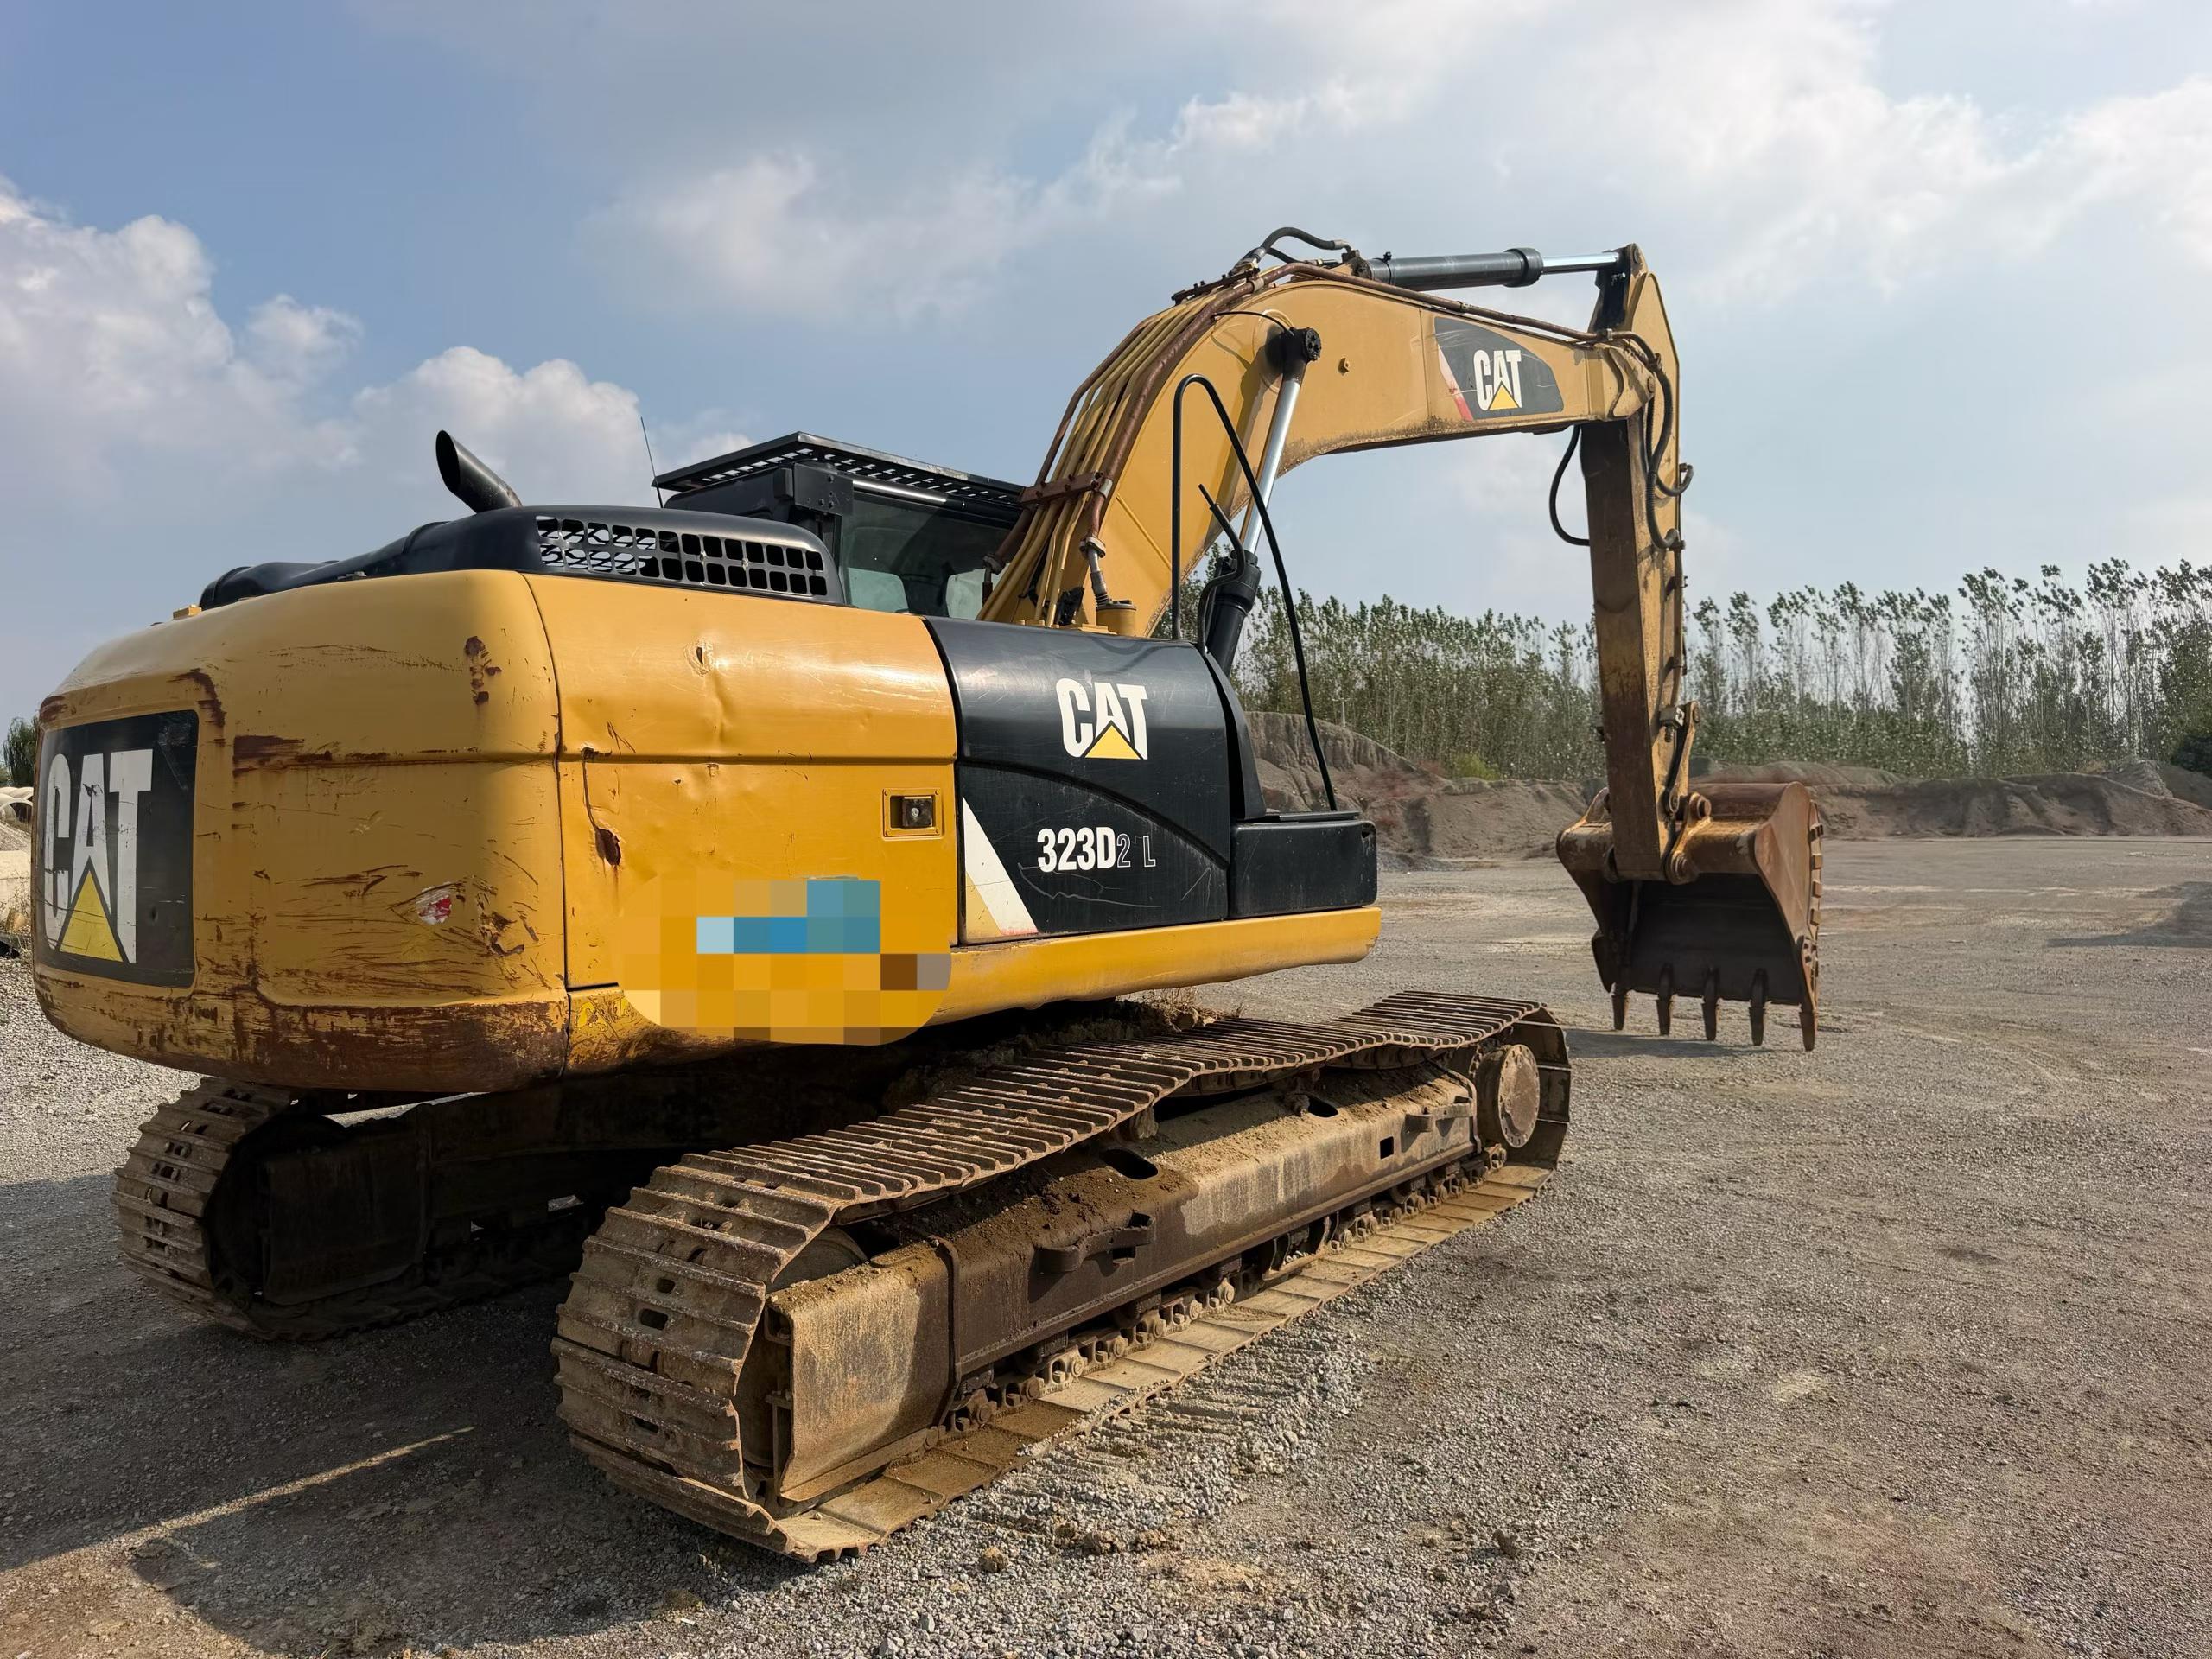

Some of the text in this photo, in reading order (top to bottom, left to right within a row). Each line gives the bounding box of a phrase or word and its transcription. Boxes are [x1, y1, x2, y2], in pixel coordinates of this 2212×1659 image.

[1473, 349, 1522, 411] CAT
[1055, 677, 1148, 760] CAT
[43, 748, 154, 964] CAT
[1142, 836, 1156, 868] L
